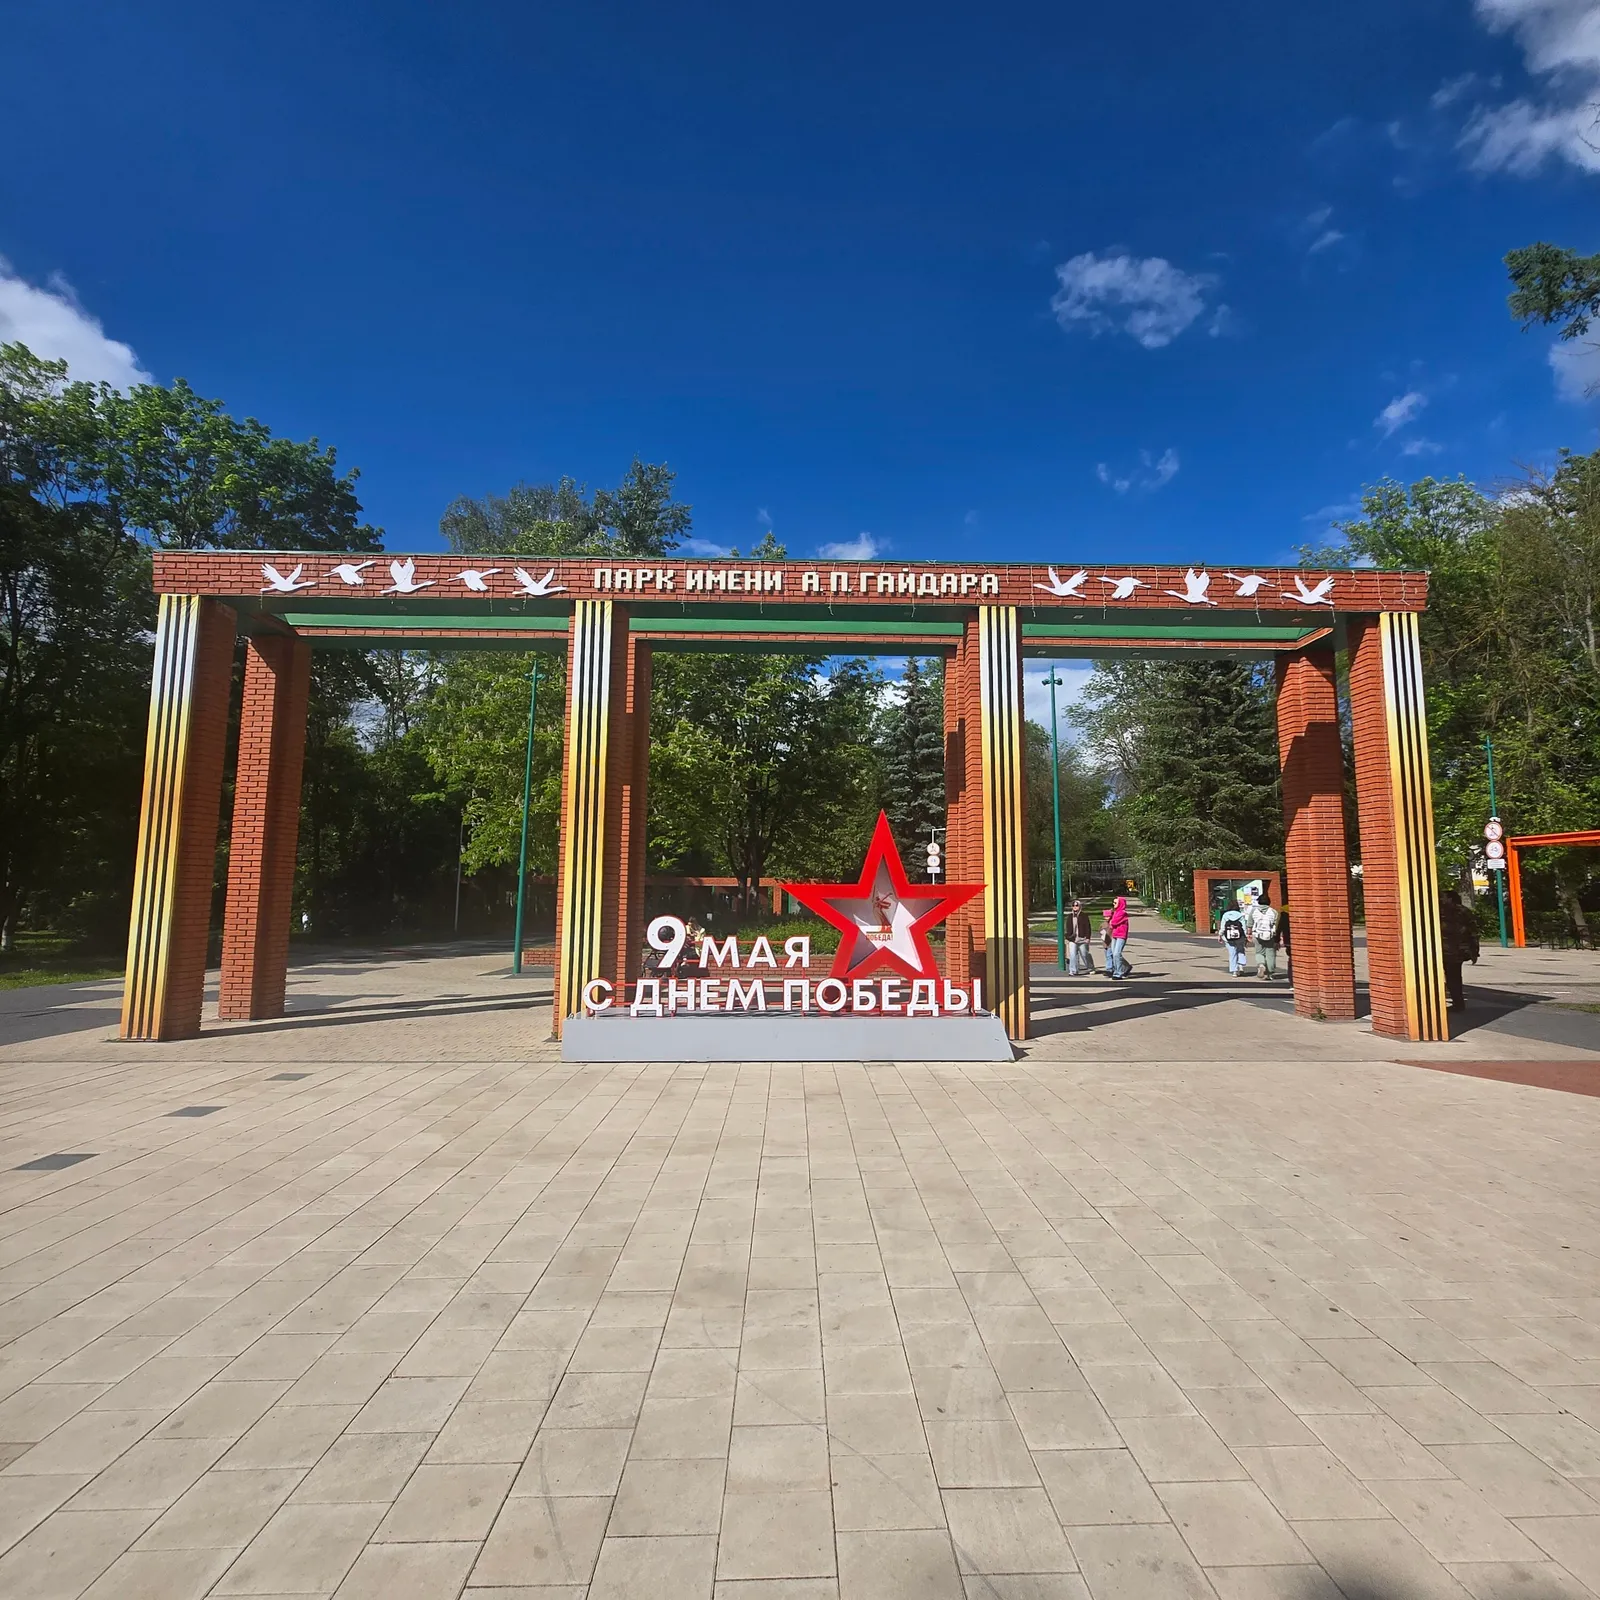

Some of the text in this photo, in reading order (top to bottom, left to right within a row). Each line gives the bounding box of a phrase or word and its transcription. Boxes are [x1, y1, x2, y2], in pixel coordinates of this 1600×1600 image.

[594, 568, 675, 590] ПАРК
[685, 570, 783, 592] ИМЕНИ
[646, 915, 810, 969] 9 МАЯ
[583, 978, 982, 1017] С ДНЕМ ПОБЕДЫ
